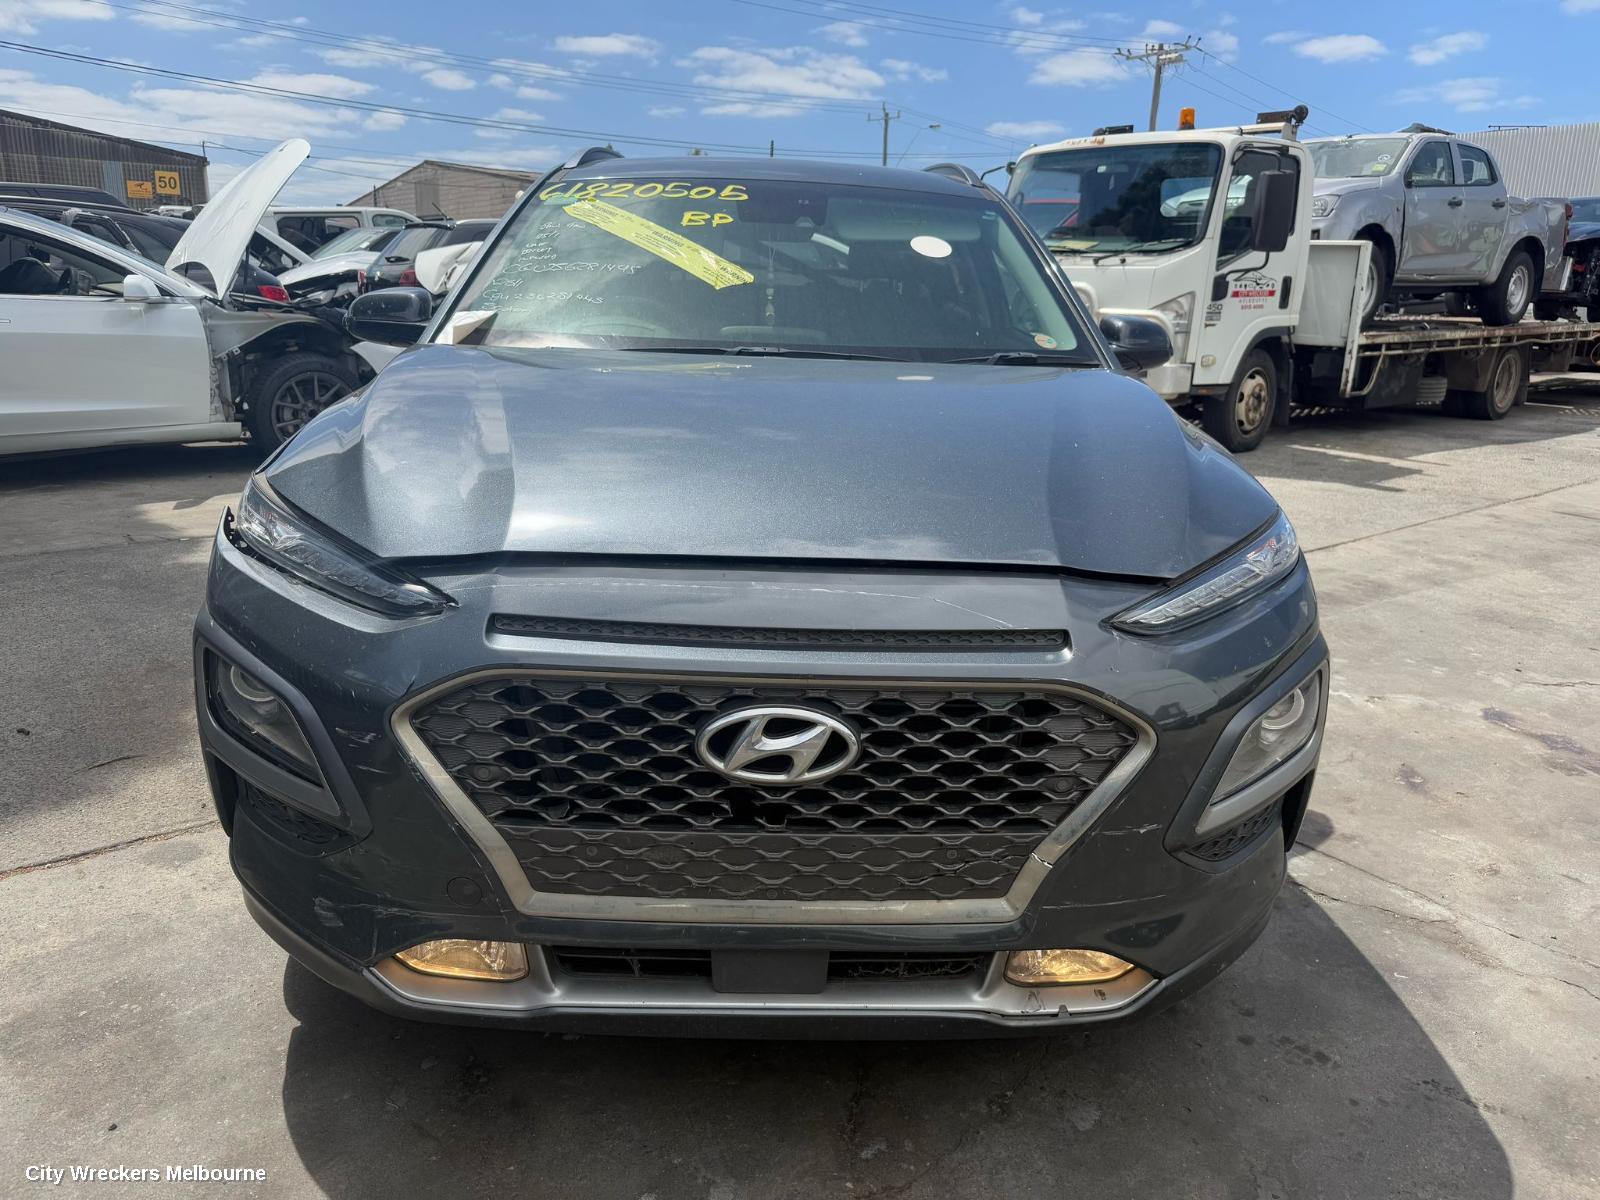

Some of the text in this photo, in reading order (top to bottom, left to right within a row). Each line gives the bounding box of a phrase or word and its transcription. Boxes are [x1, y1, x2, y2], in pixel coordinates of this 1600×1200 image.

[158, 176, 177, 190] 50
[539, 182, 749, 201] 61820505
[1207, 304, 1223, 312] 450
